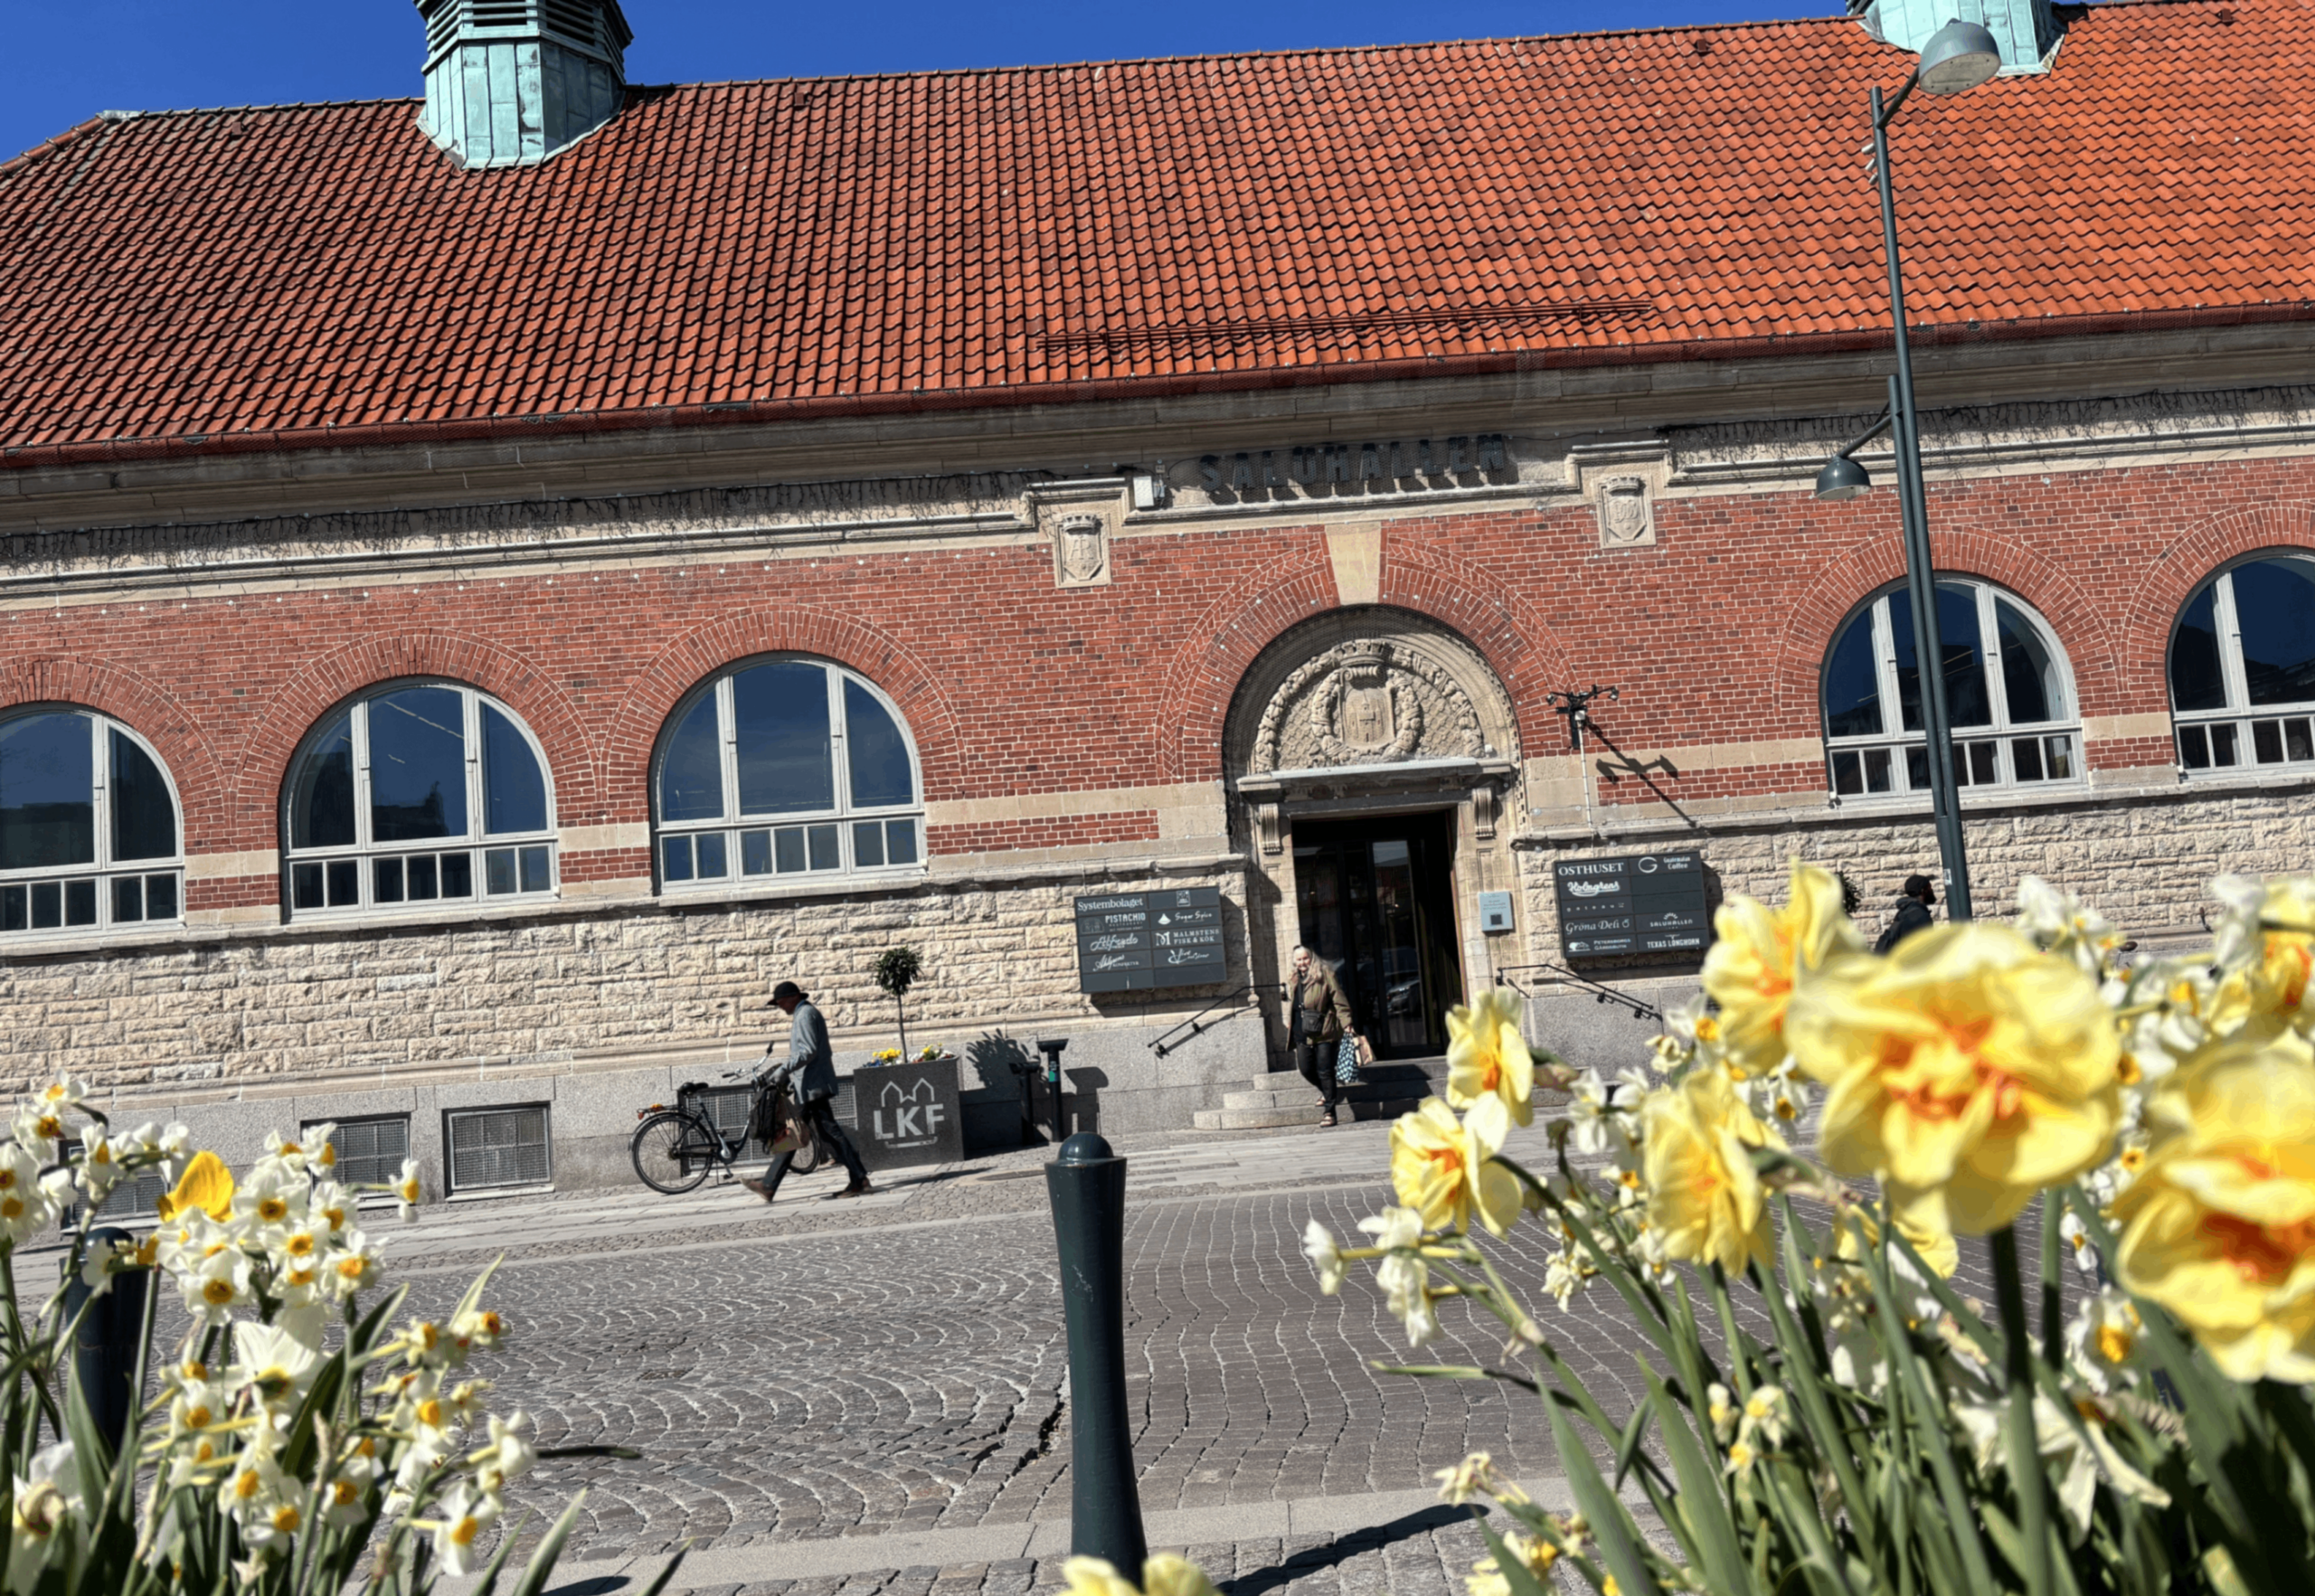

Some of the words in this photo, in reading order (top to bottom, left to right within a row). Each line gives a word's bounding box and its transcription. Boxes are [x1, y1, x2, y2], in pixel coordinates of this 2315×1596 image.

[1199, 434, 1505, 493] SALUHALLEN
[1558, 862, 1625, 876] OSTHUSET
[1077, 897, 1144, 911] Systembolaget
[1105, 912, 1146, 923] PISTACHIO
[1173, 929, 1220, 938] MALMSTENS
[1565, 922, 1597, 935] Gröna
[1597, 919, 1620, 930] Deli
[1090, 932, 1139, 951] Alfredo
[1199, 935, 1215, 943] KÖK
[1647, 940, 1667, 949] TEXAS
[1668, 938, 1700, 948] LONGHORN
[873, 1103, 945, 1140] LKF
